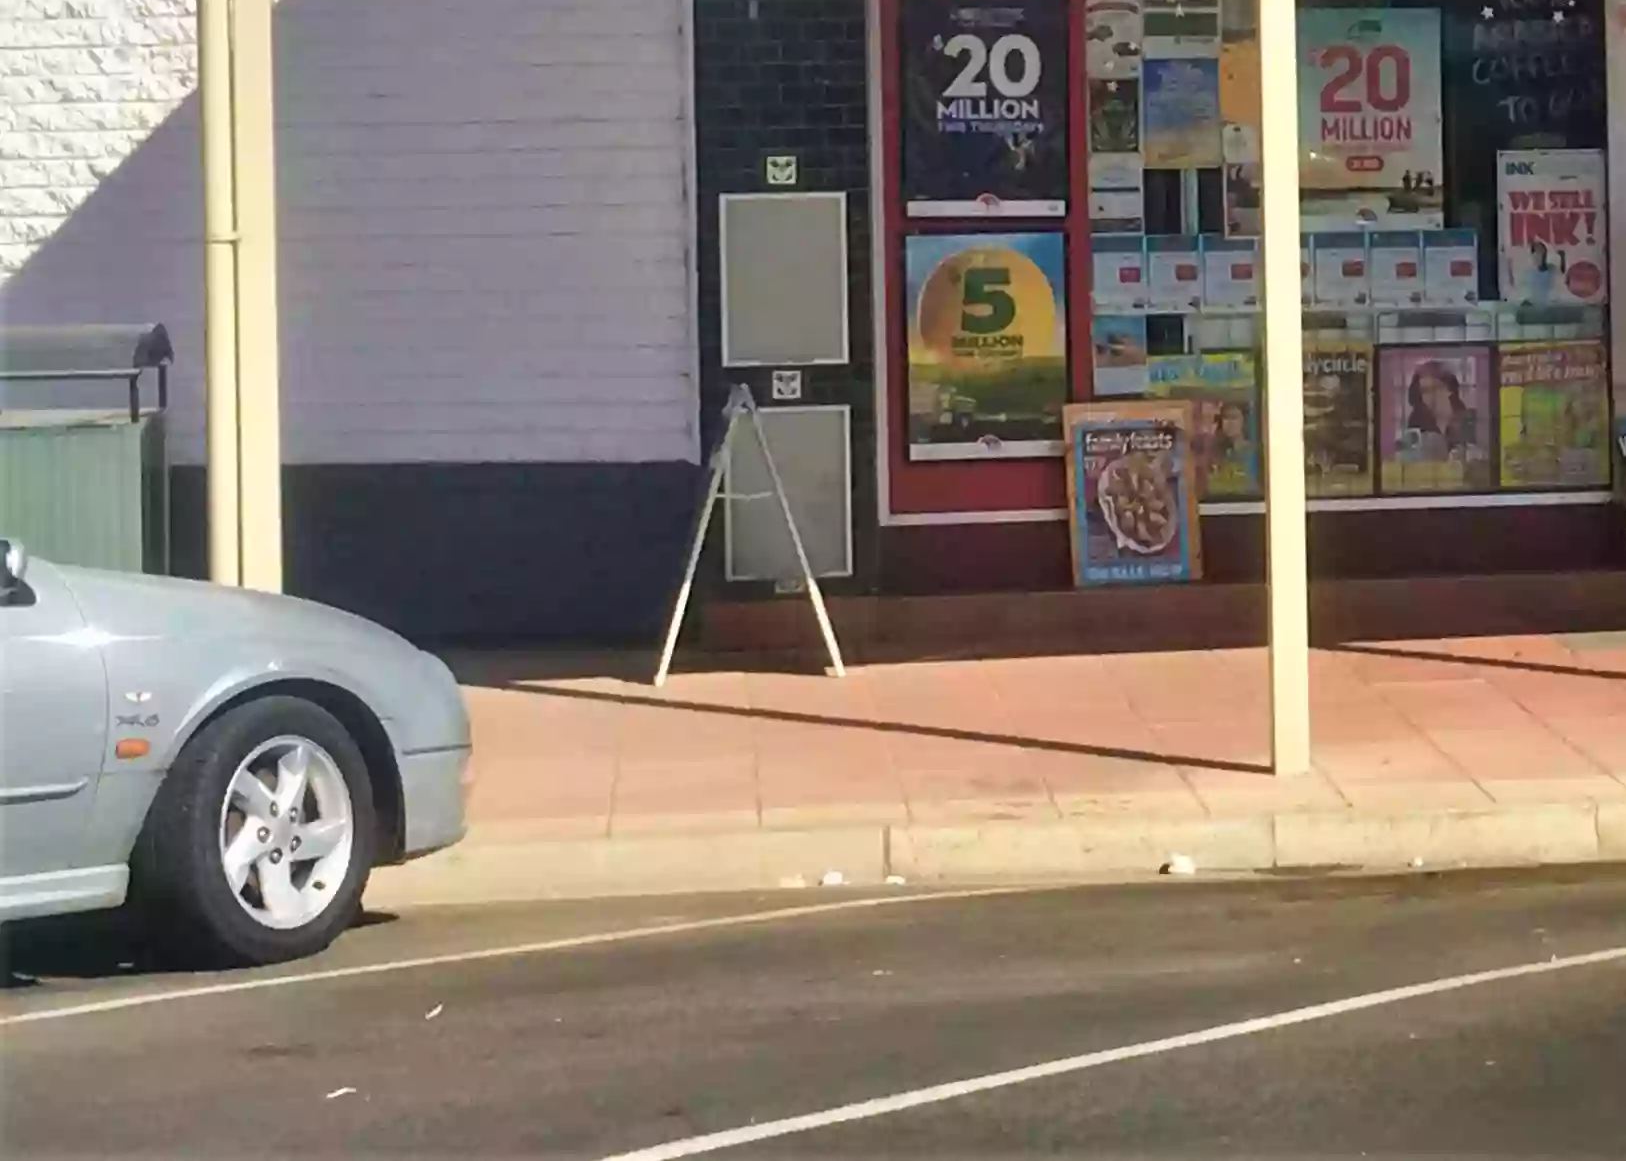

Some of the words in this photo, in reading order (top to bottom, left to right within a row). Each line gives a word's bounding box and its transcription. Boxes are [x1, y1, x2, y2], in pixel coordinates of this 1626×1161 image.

[936, 98, 1040, 120] MILLION
[1321, 116, 1412, 142] MILLION
[1509, 212, 1597, 247] INK!
